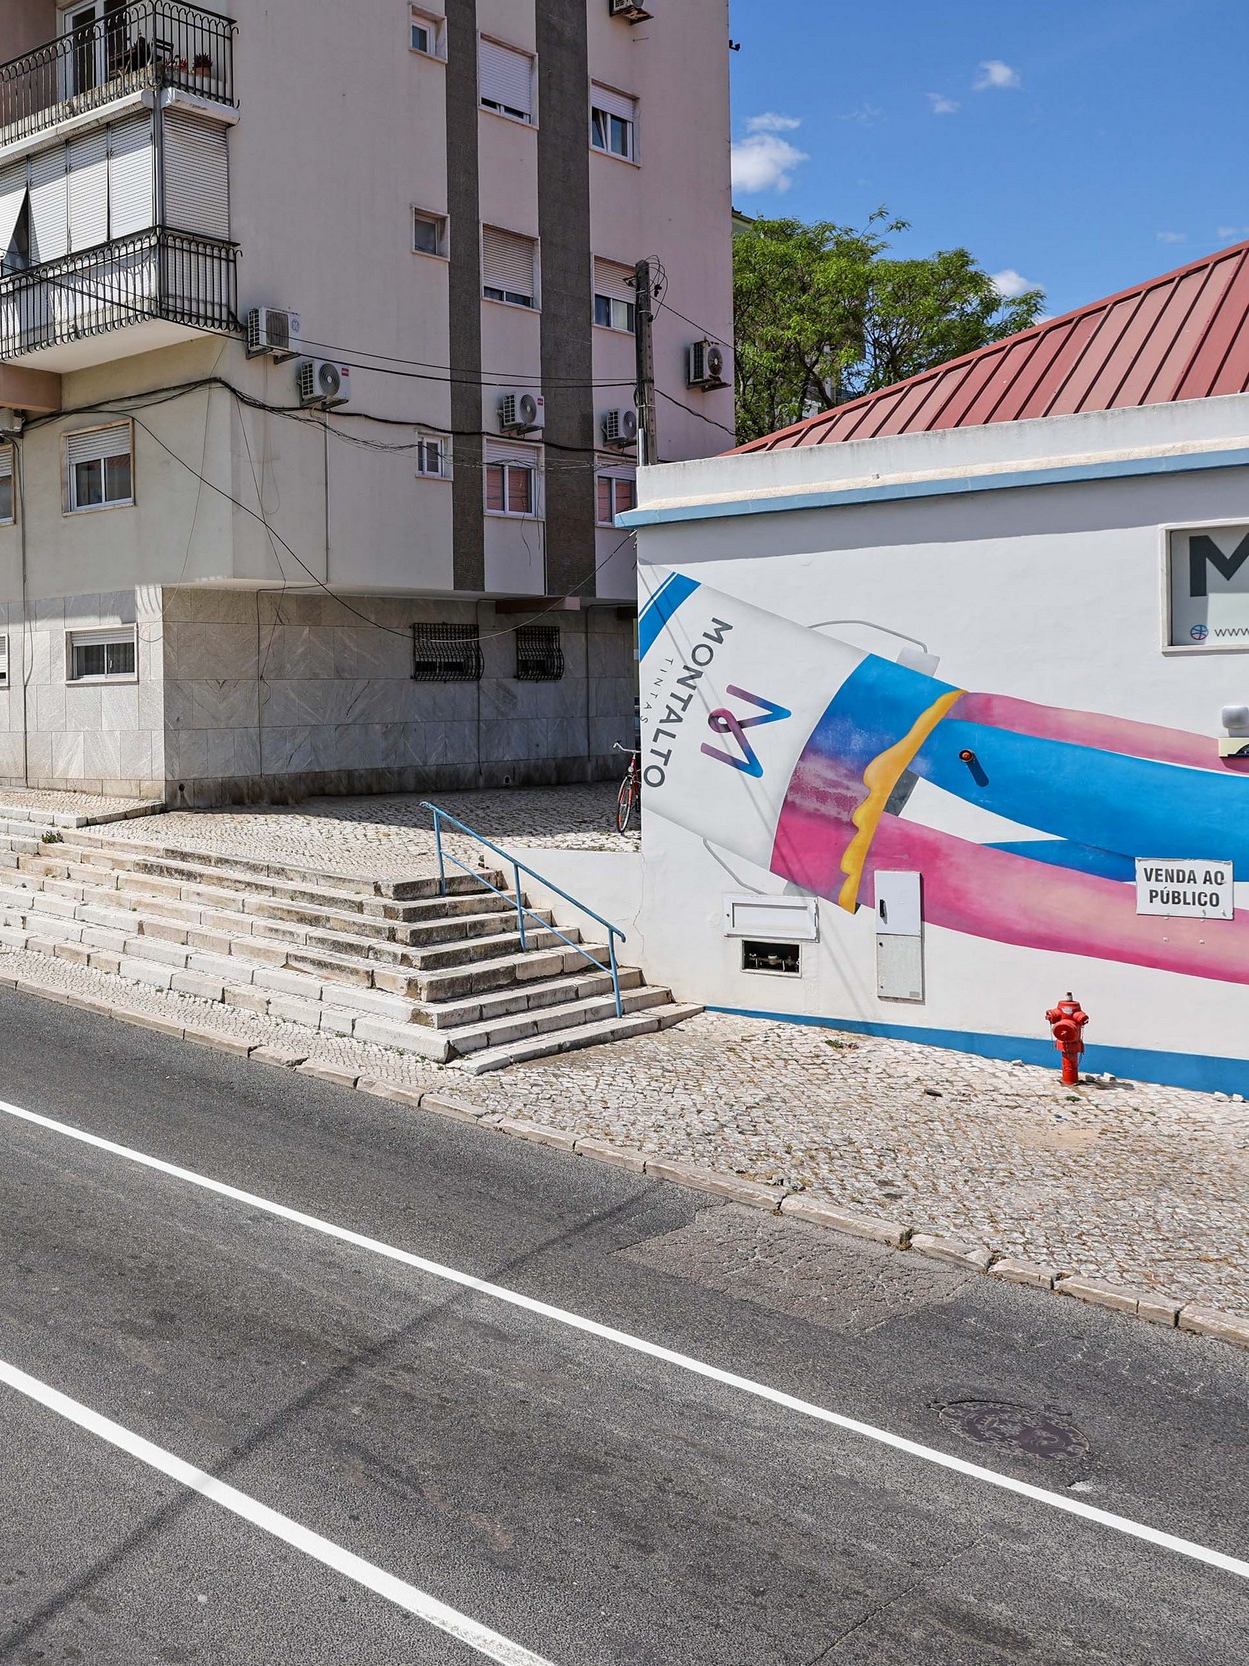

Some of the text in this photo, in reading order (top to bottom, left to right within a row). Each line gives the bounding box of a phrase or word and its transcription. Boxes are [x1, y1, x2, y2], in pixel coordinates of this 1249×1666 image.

[640, 657, 674, 724] TINTAS
[643, 617, 734, 788] MONTALTO
[1143, 867, 1225, 885] VENDA AO
[1149, 886, 1220, 907] PÚBLICO
